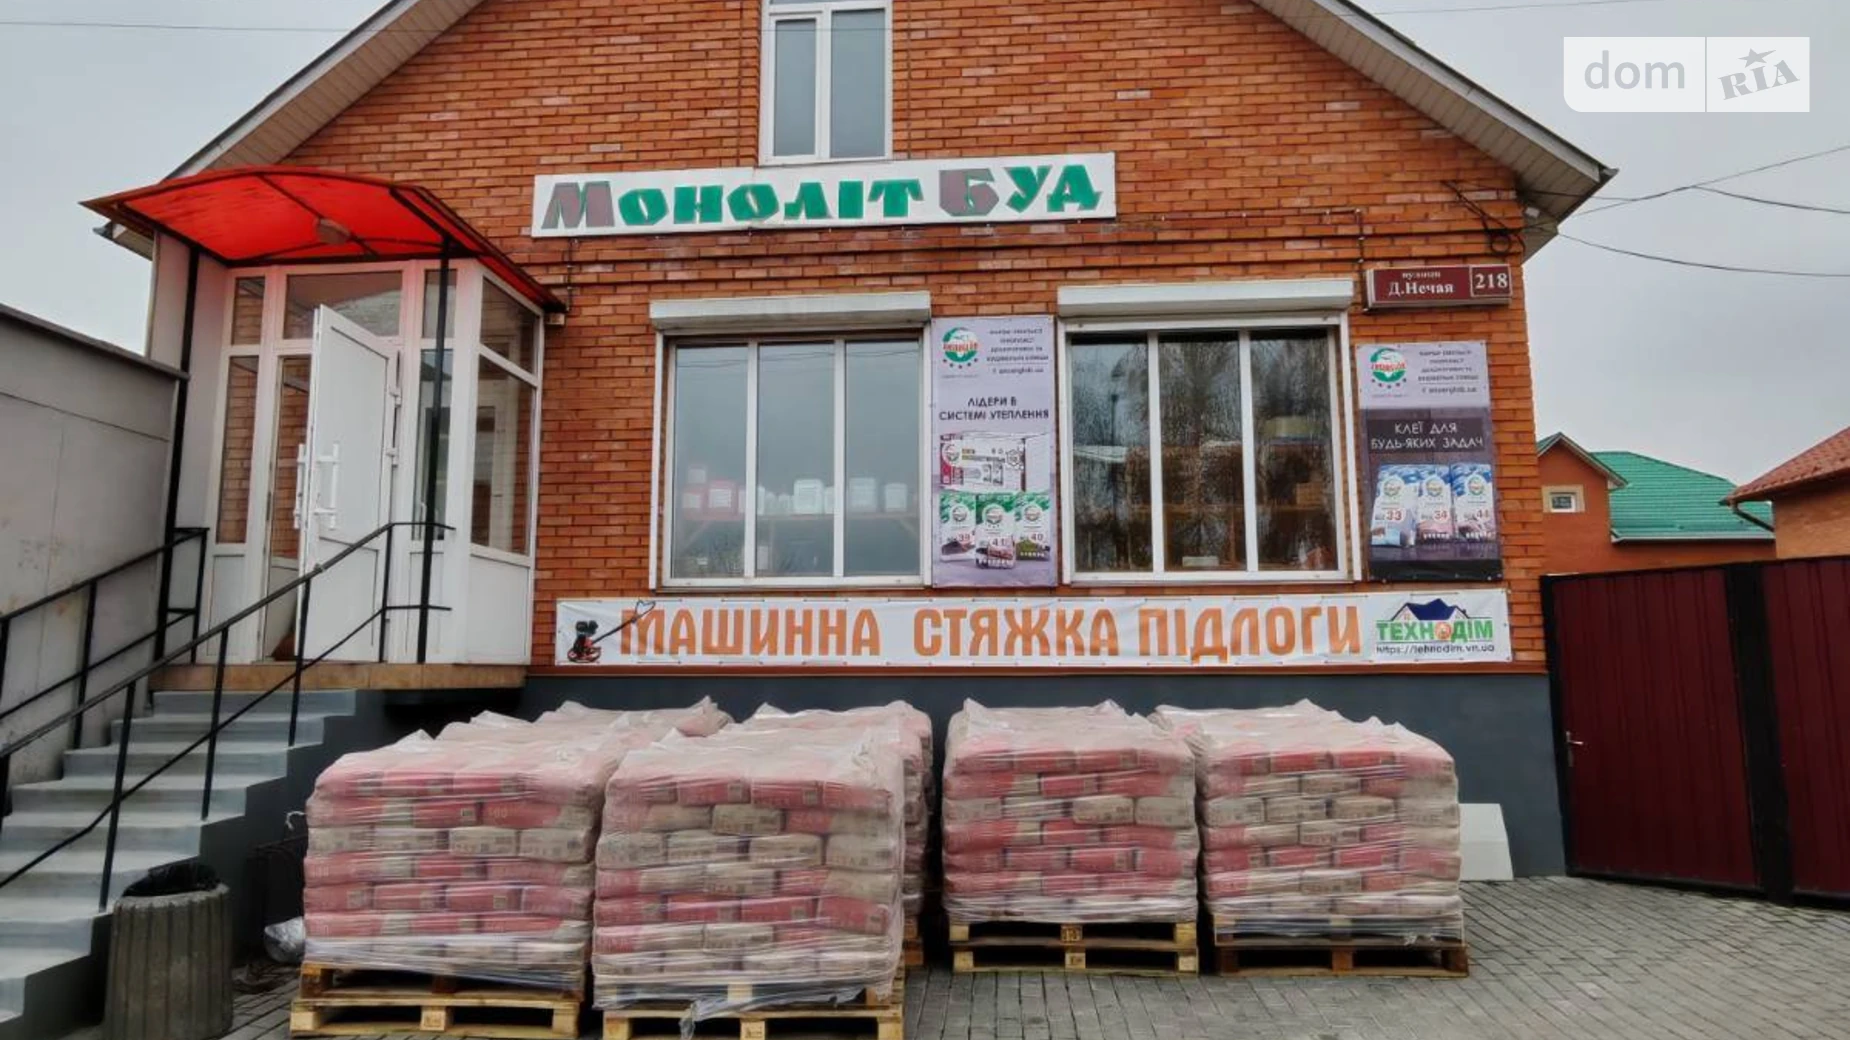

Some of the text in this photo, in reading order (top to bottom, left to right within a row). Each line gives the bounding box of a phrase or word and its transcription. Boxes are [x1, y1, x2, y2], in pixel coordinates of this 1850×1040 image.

[1474, 272, 1508, 290] 218
[1388, 281, 1454, 297] Д.Нечая
[967, 396, 1018, 408] ЛІДЕРИ В
[938, 408, 1050, 421] СИСТЕМІ УТЕПЛЕННЯ
[1394, 420, 1458, 435] КЛЕЇ ДЛЯ
[1370, 437, 1484, 450] БУДЬ-ЯКИХ ЗАДАЧ
[619, 604, 1361, 665] МАШИННА СТЯЖКА ПІДЛОГИ
[1376, 643, 1496, 655] https://tehnodim.vn.ua
